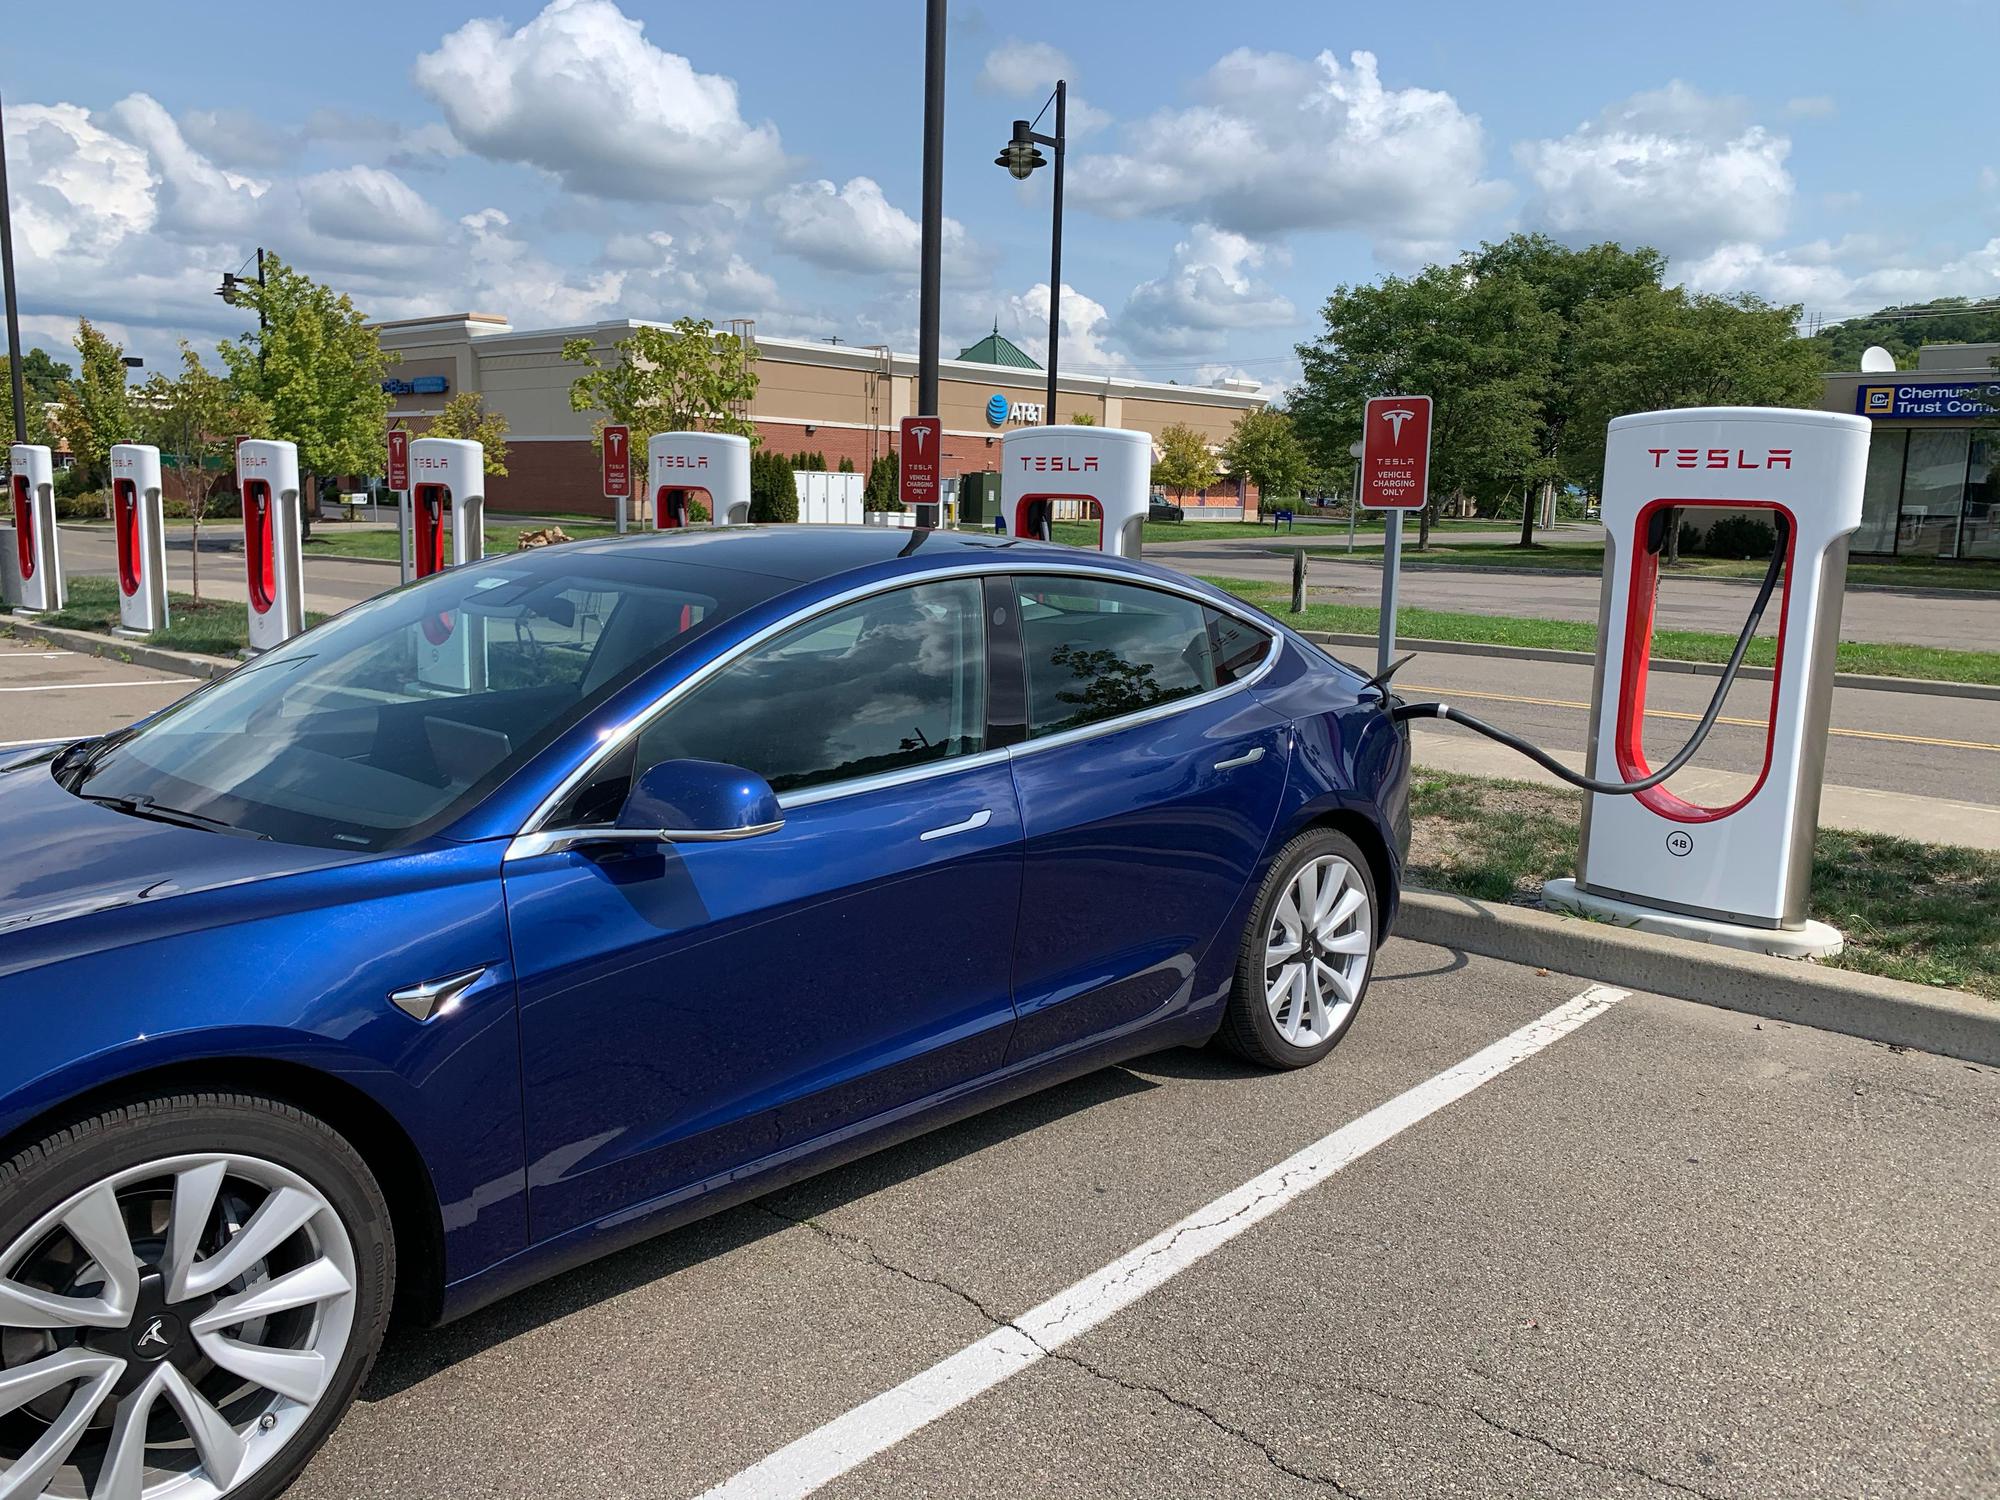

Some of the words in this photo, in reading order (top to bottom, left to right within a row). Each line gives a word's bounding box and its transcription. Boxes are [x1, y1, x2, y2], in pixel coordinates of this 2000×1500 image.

[1009, 402, 1045, 422] AT&T
[1897, 401, 1942, 413] Trust
[413, 458, 448, 468] TESLA
[657, 456, 708, 468] TESLA
[1020, 457, 1098, 471] TESLA
[1648, 449, 1793, 470] TESLA
[1382, 488, 1405, 496] ONLY
[1671, 839, 1687, 848] 4B
